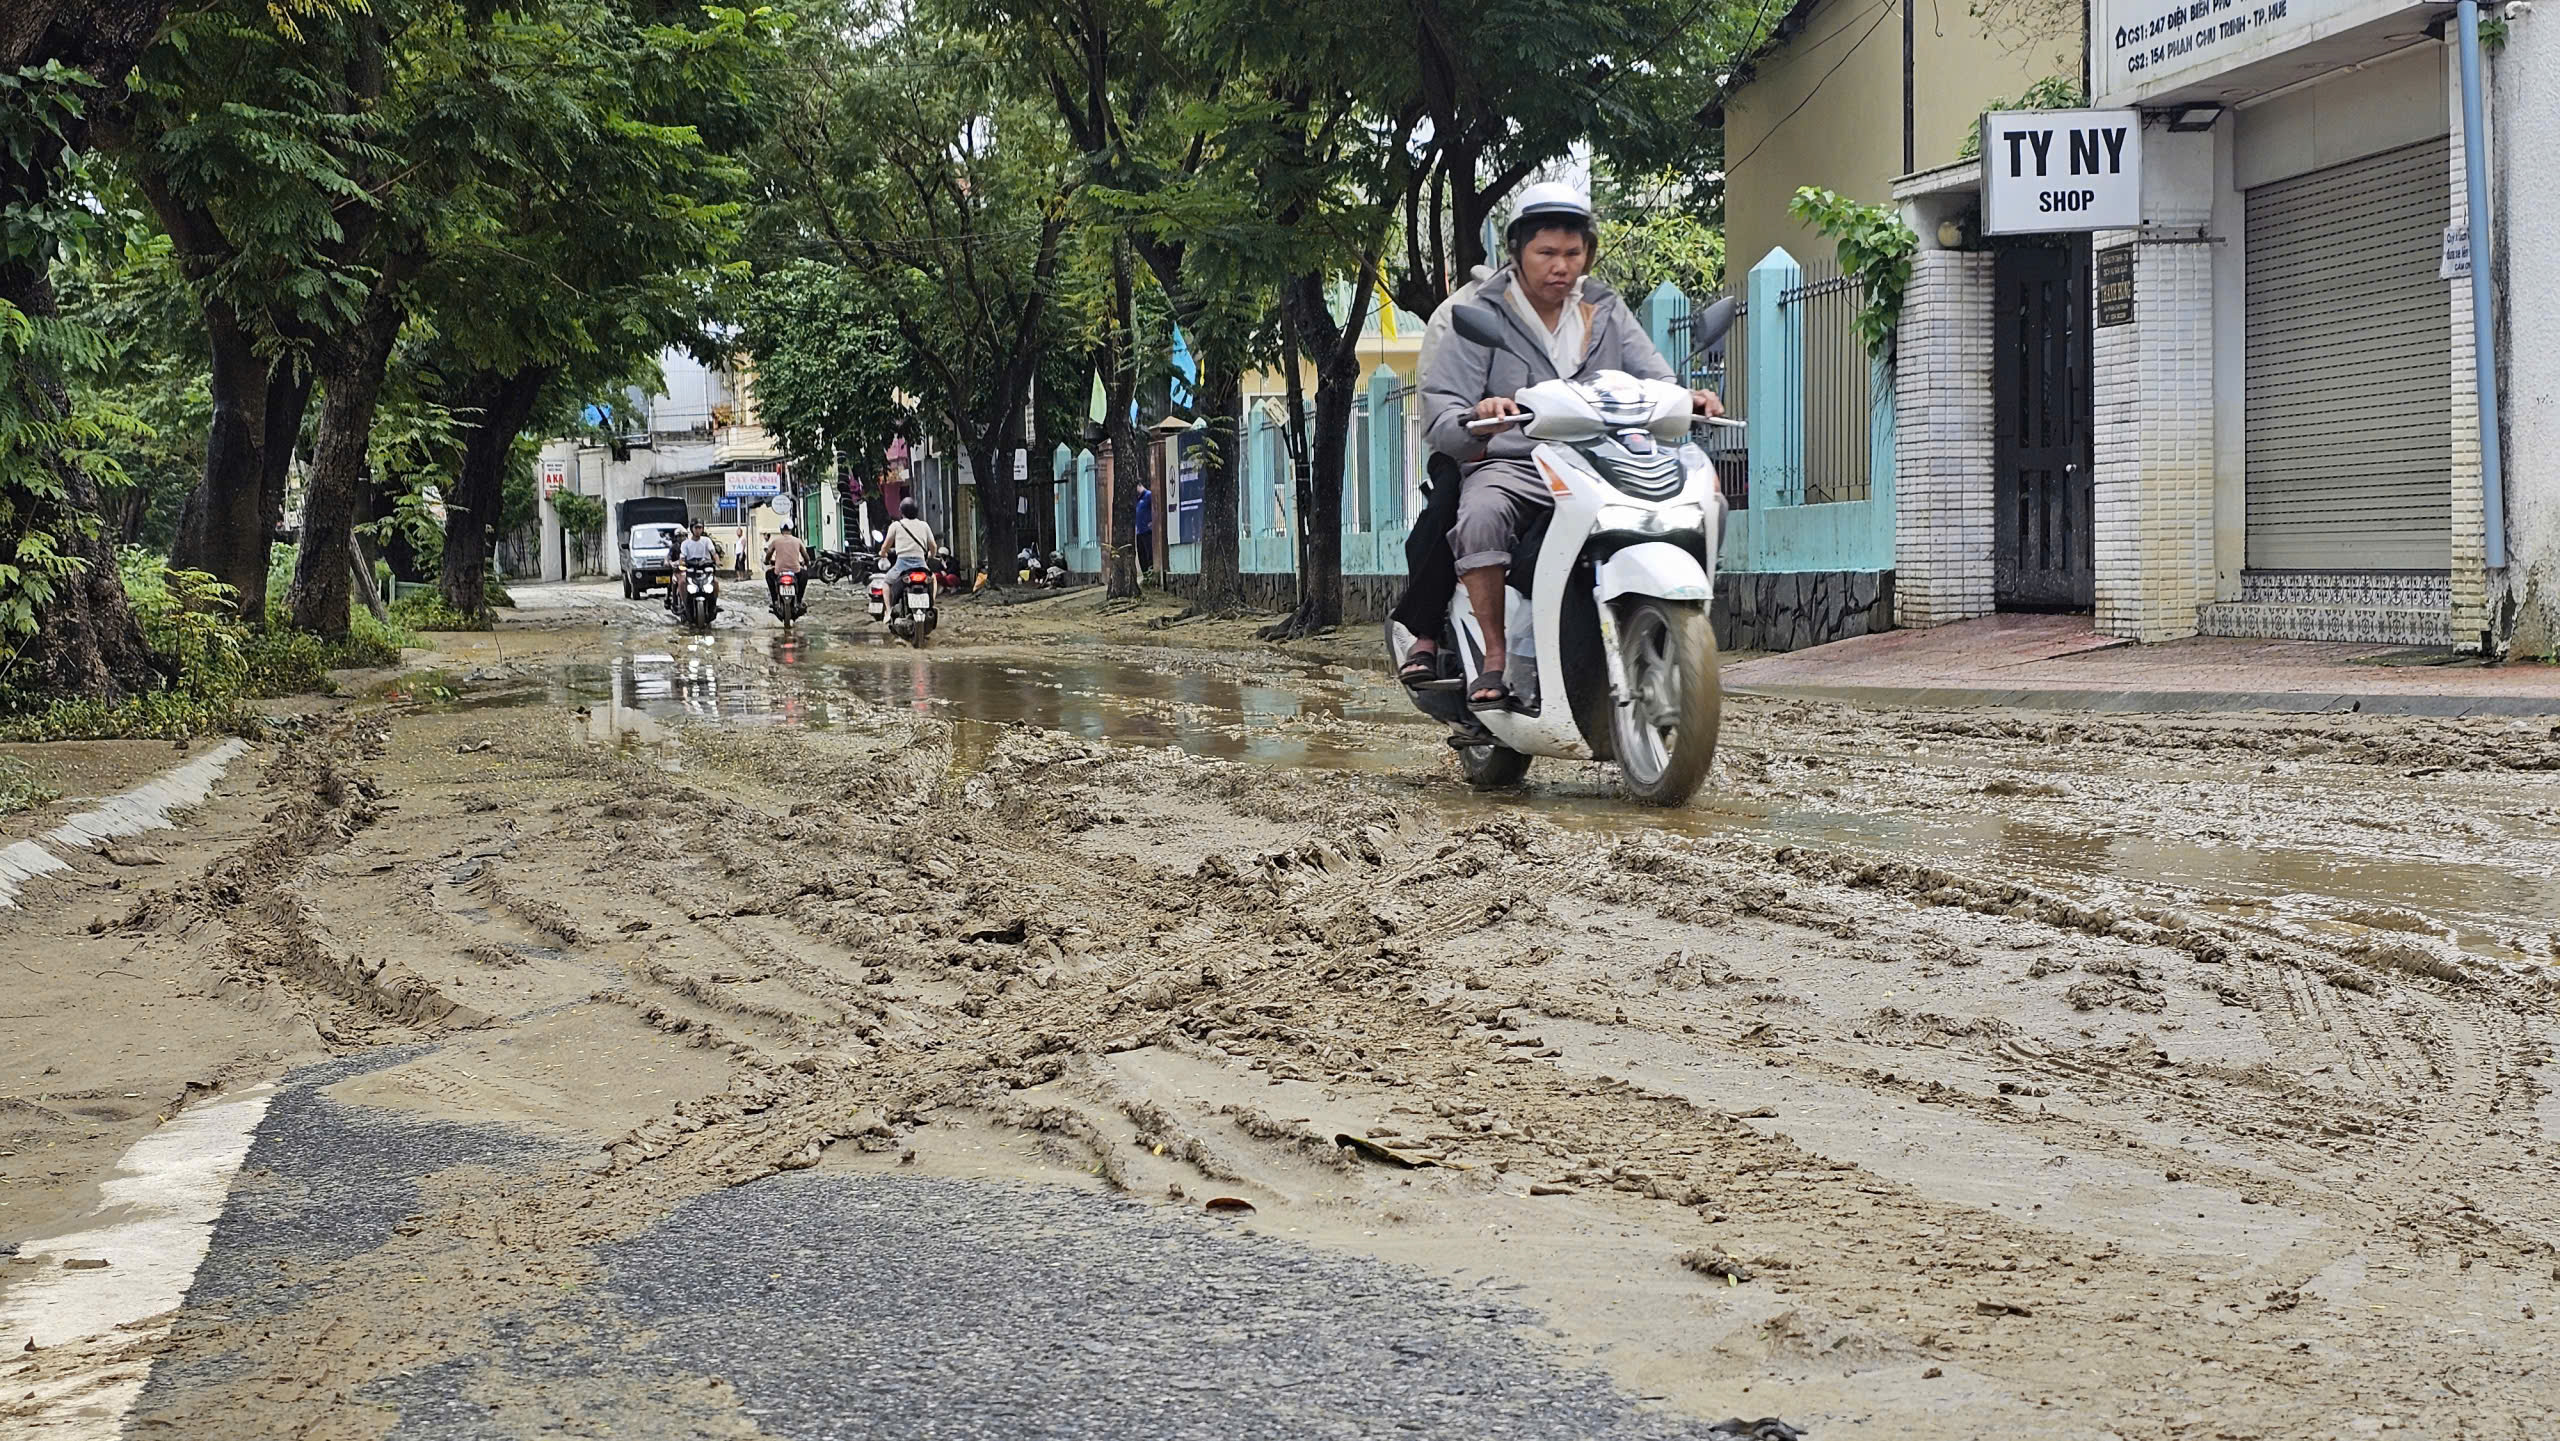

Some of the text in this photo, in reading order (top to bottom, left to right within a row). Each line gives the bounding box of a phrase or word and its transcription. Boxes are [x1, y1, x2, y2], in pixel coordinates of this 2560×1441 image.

[2127, 24, 2148, 45] CS1:
[2150, 16, 2166, 37] 247
[2168, 6, 2187, 32] ĐIỆN
[2128, 52, 2149, 73] CS2:
[2151, 45, 2165, 65] 154
[2167, 35, 2193, 59] PHAN
[2196, 26, 2216, 48] CHU
[2003, 128, 2128, 178] TY NY
[2039, 190, 2095, 213] SHOP
